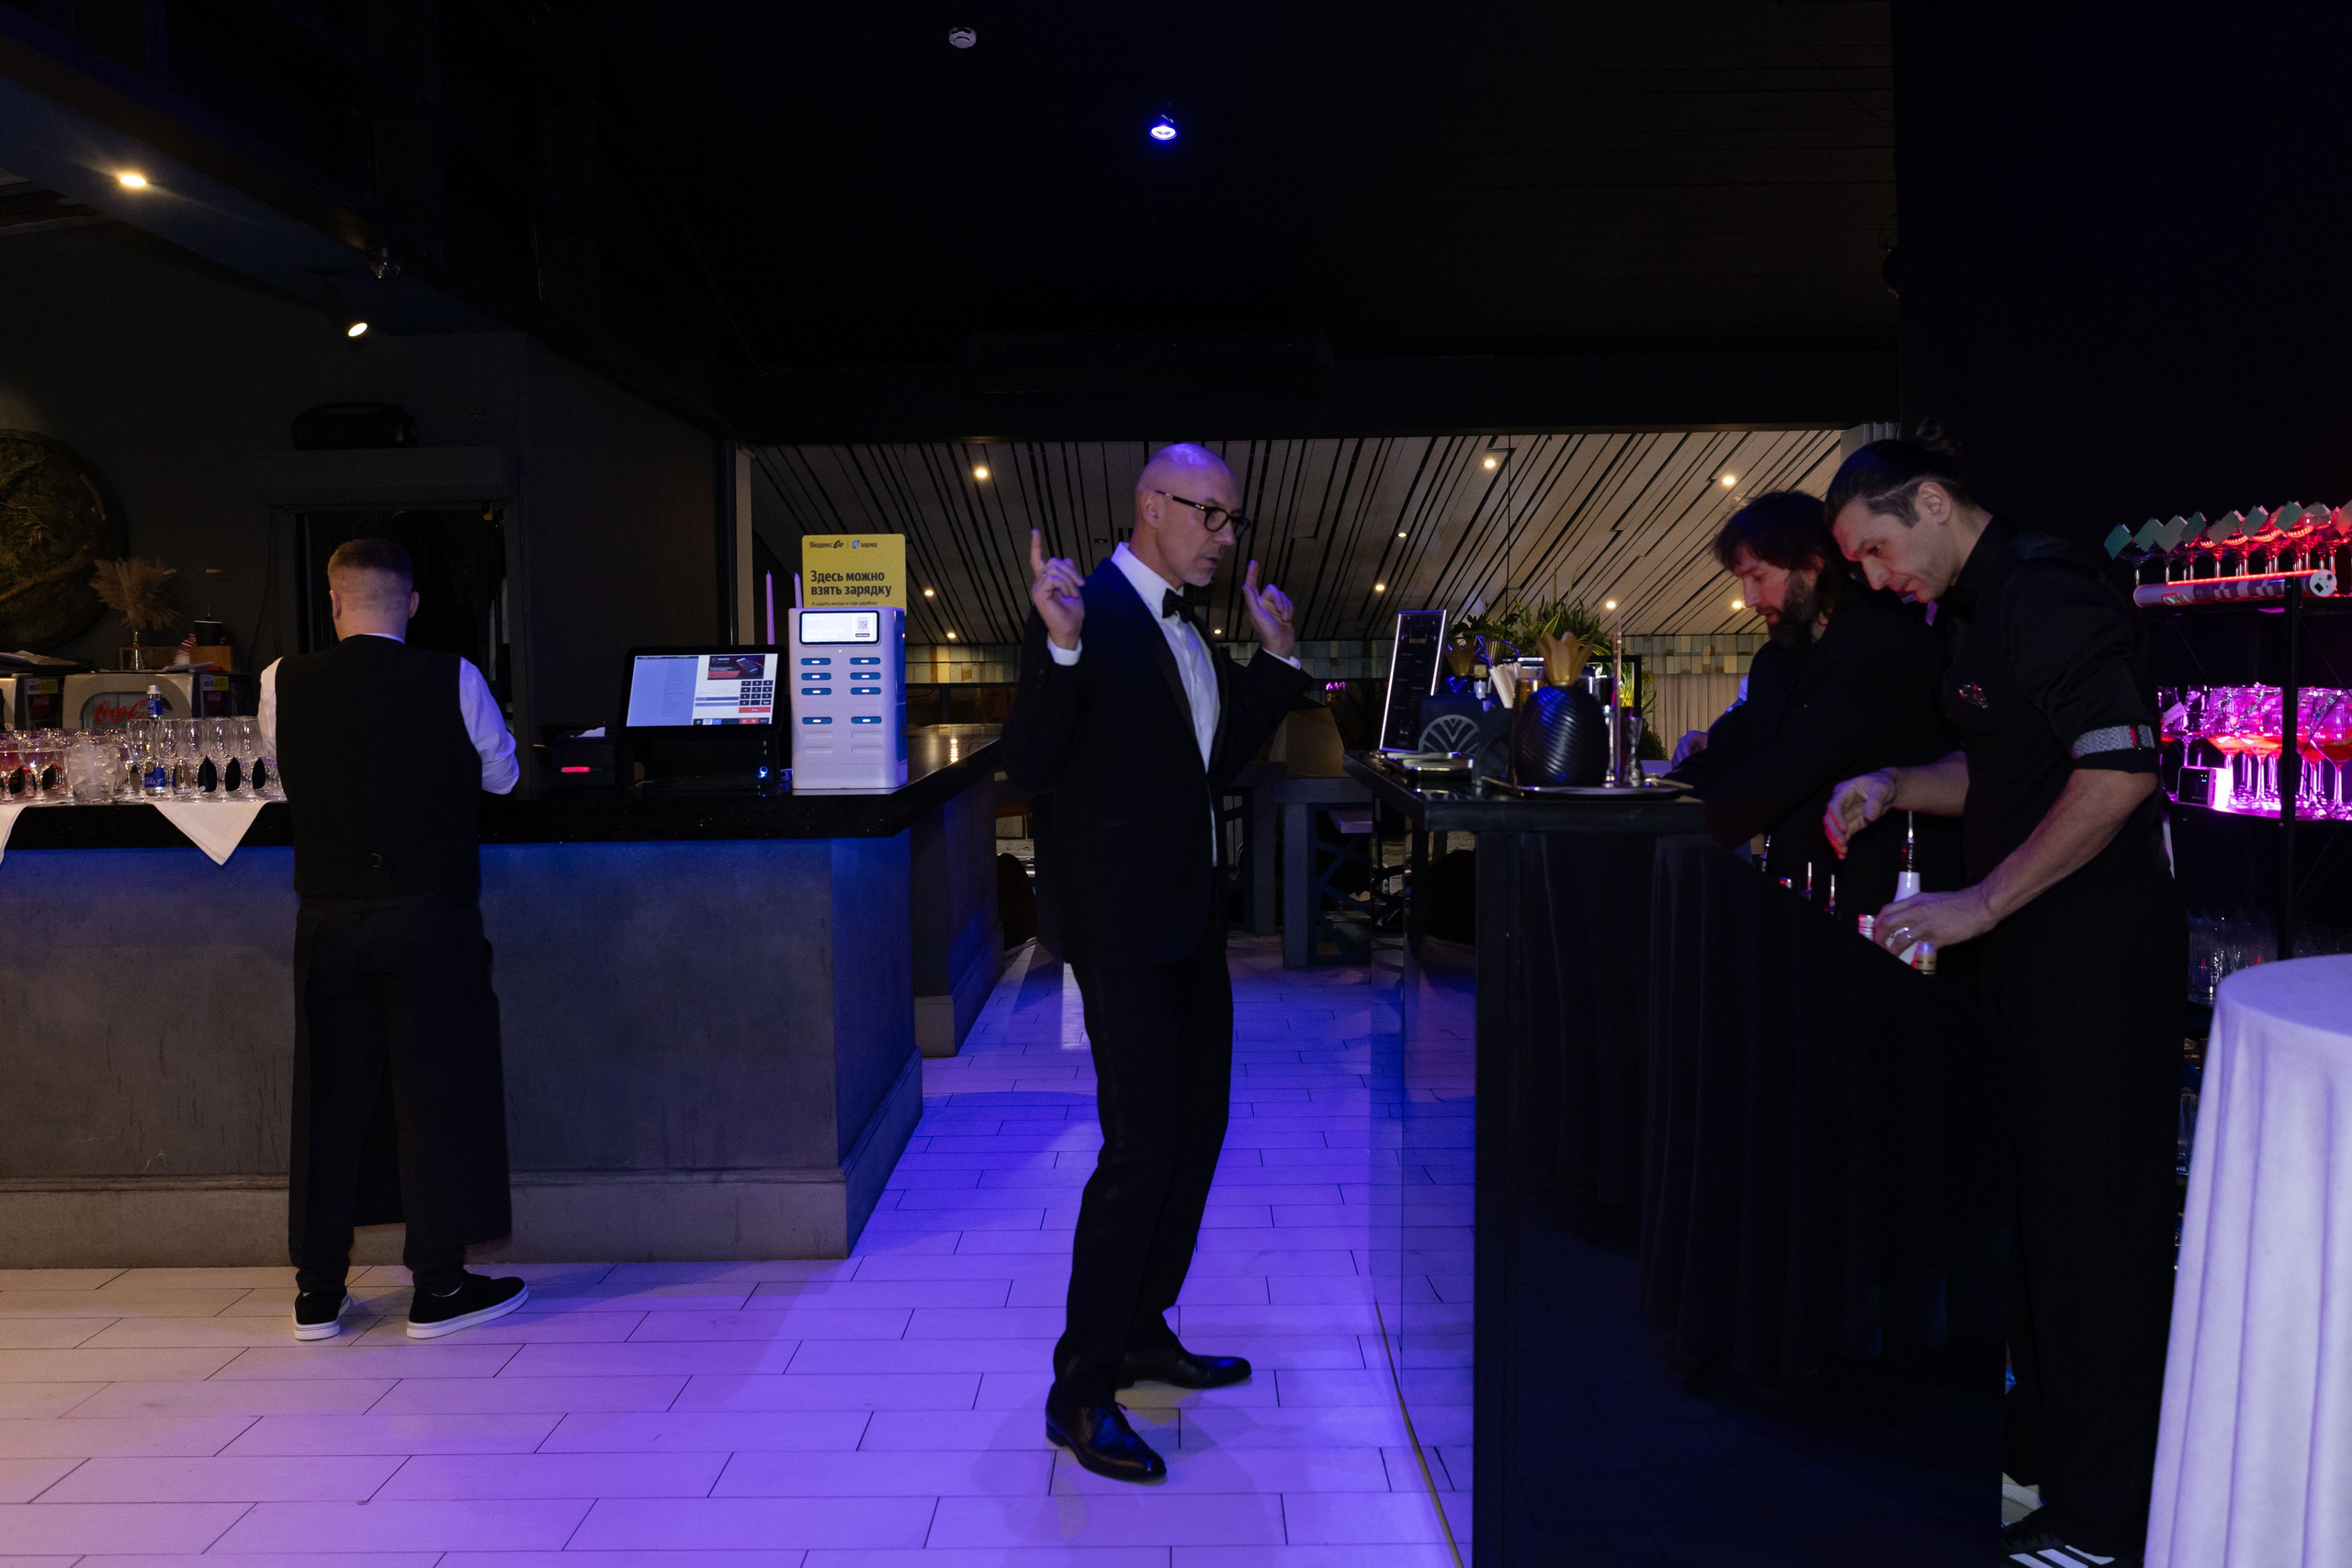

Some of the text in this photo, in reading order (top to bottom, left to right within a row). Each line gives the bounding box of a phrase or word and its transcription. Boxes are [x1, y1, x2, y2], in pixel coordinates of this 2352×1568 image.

[833, 540, 844, 548] Go
[810, 570, 885, 583] Здесь можно
[811, 585, 892, 597] взять зарядку
[94, 700, 149, 724] Coca-Co
